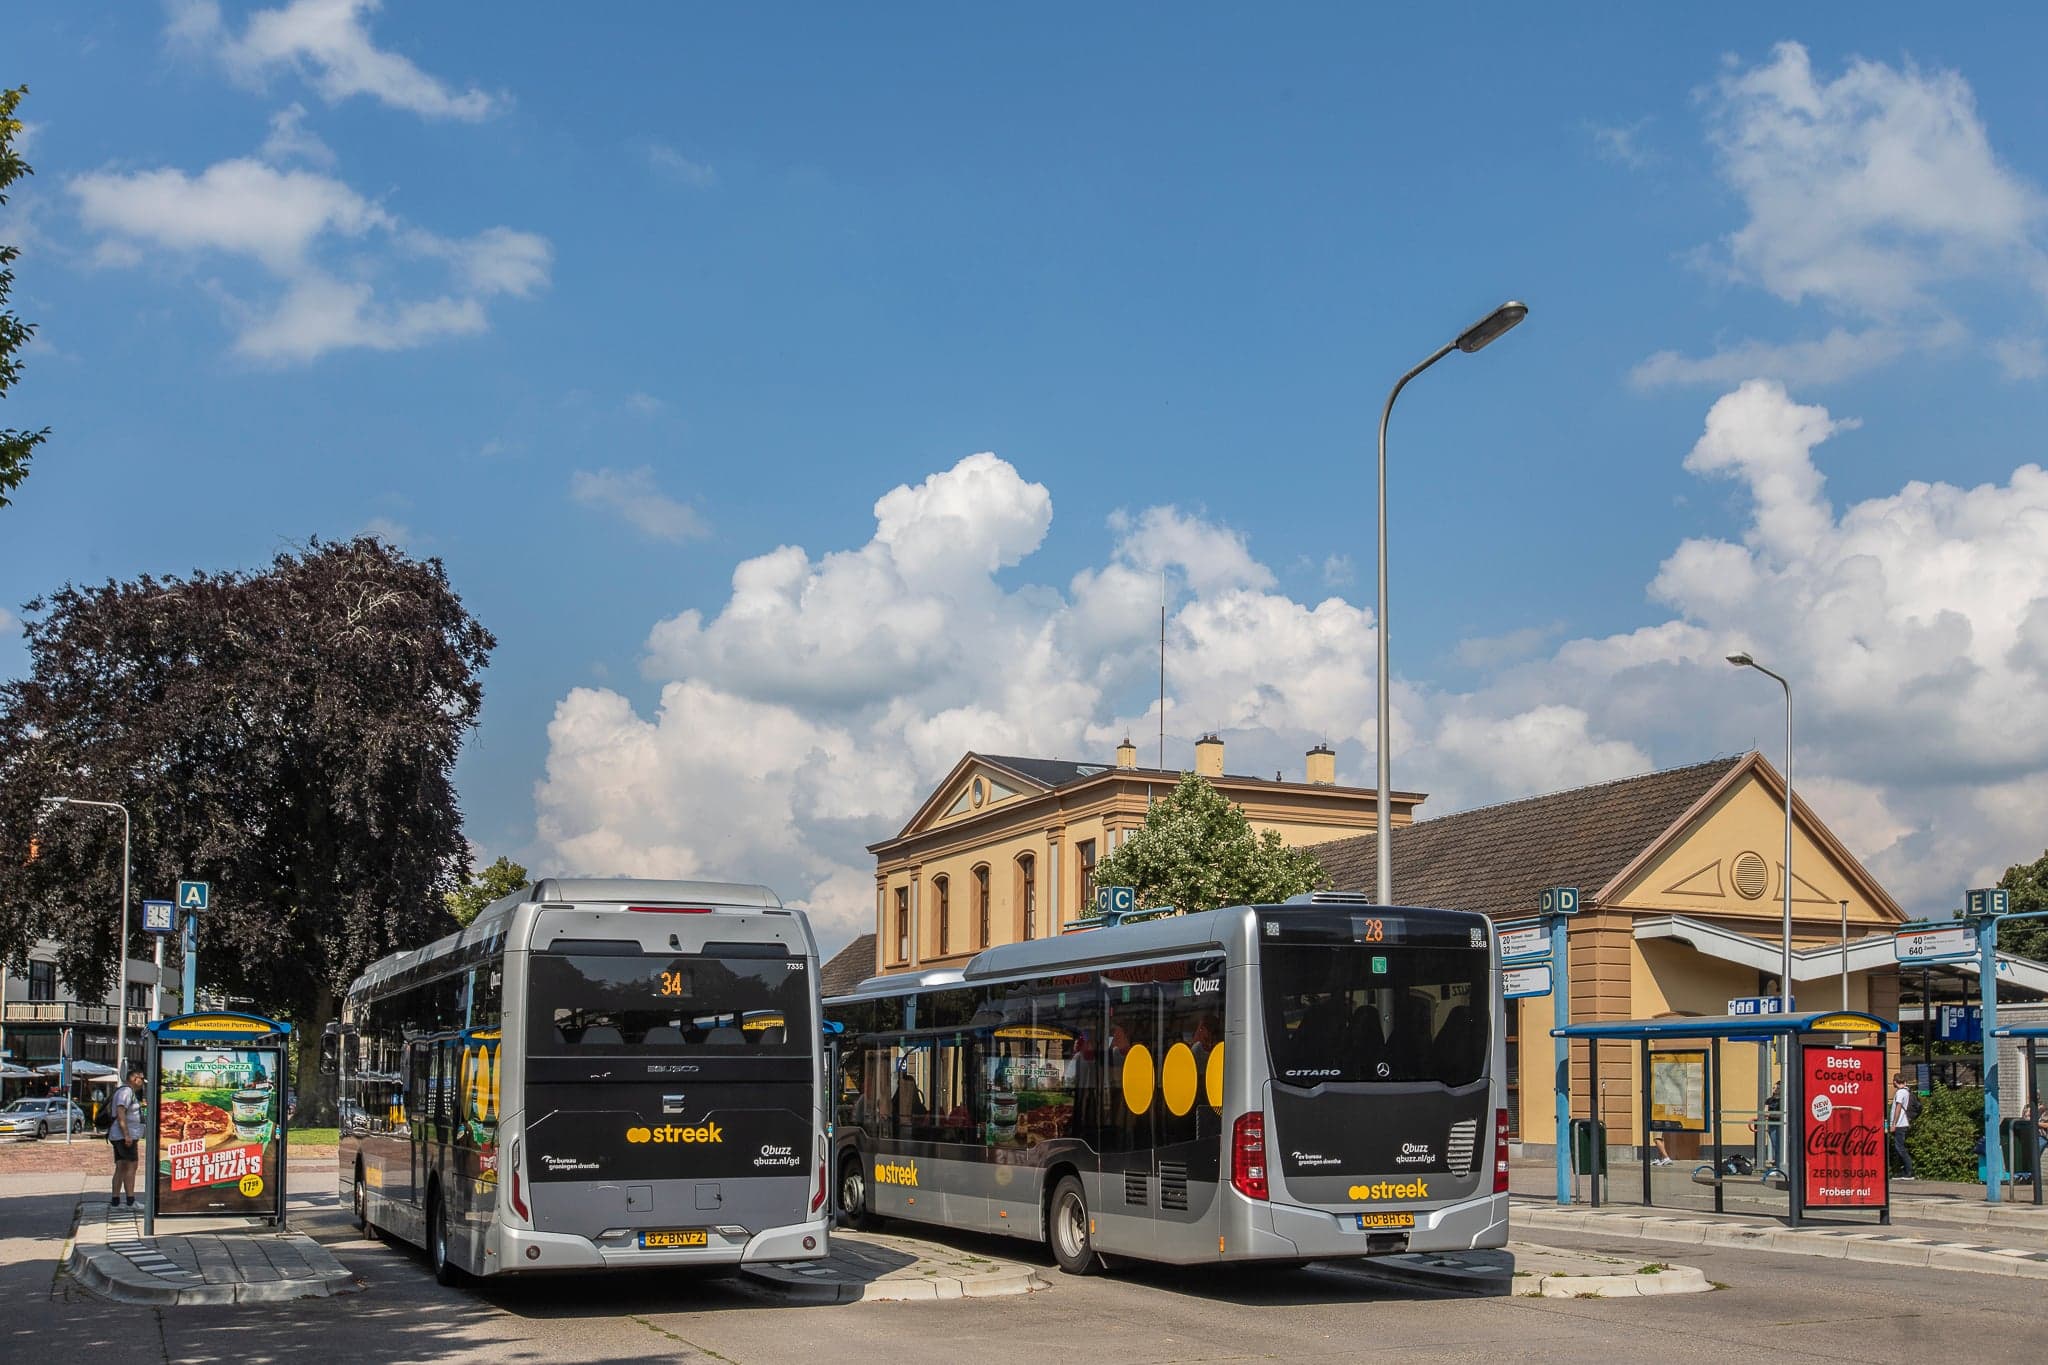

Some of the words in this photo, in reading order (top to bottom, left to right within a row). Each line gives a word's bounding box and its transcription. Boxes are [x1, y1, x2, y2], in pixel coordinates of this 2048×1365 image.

[185, 886, 201, 904] A
[1100, 891, 1107, 909] C
[1116, 891, 1129, 908] C
[1543, 893, 1551, 909] D
[1562, 892, 1573, 908] D
[1972, 895, 1982, 911] E
[1994, 894, 2003, 910] E
[1365, 919, 1383, 942] 28
[1502, 935, 1510, 945] 20
[1913, 936, 1923, 945] 40
[1503, 946, 1510, 955] 32
[1909, 946, 1923, 955] 640
[786, 962, 804, 970] 7335
[660, 971, 682, 996] 34
[1193, 977, 1220, 995] Qbuzz
[1827, 1056, 1861, 1069] Beste
[1815, 1069, 1873, 1081] Coca-Cola
[1829, 1082, 1859, 1094] ooit?
[1814, 1100, 1829, 1109] NEW
[653, 1121, 723, 1143] streek
[1807, 1124, 1881, 1156] Coca-Cola
[170, 1140, 203, 1156] GRATIS
[761, 1144, 792, 1157] Qbuzz
[1402, 1143, 1429, 1154] Qbuzz
[175, 1159, 182, 1169] 2
[183, 1156, 201, 1168] BEN
[202, 1154, 210, 1165] &
[210, 1148, 246, 1164] JERRY'S
[753, 1156, 800, 1167] qbuzz.nl/gd
[175, 1168, 189, 1180] BIJ
[190, 1166, 201, 1184] 2
[204, 1156, 260, 1182] PIZZA'S
[886, 1159, 919, 1187] streek
[1813, 1169, 1840, 1178] ZERO
[1843, 1169, 1878, 1178] SUGAR
[1371, 1177, 1429, 1199] streek
[1819, 1187, 1854, 1196] Probeer
[1856, 1187, 1871, 1196] nu!
[1365, 1214, 1411, 1225] 00-BHT-6
[649, 1232, 703, 1244] 82-BNV-2
